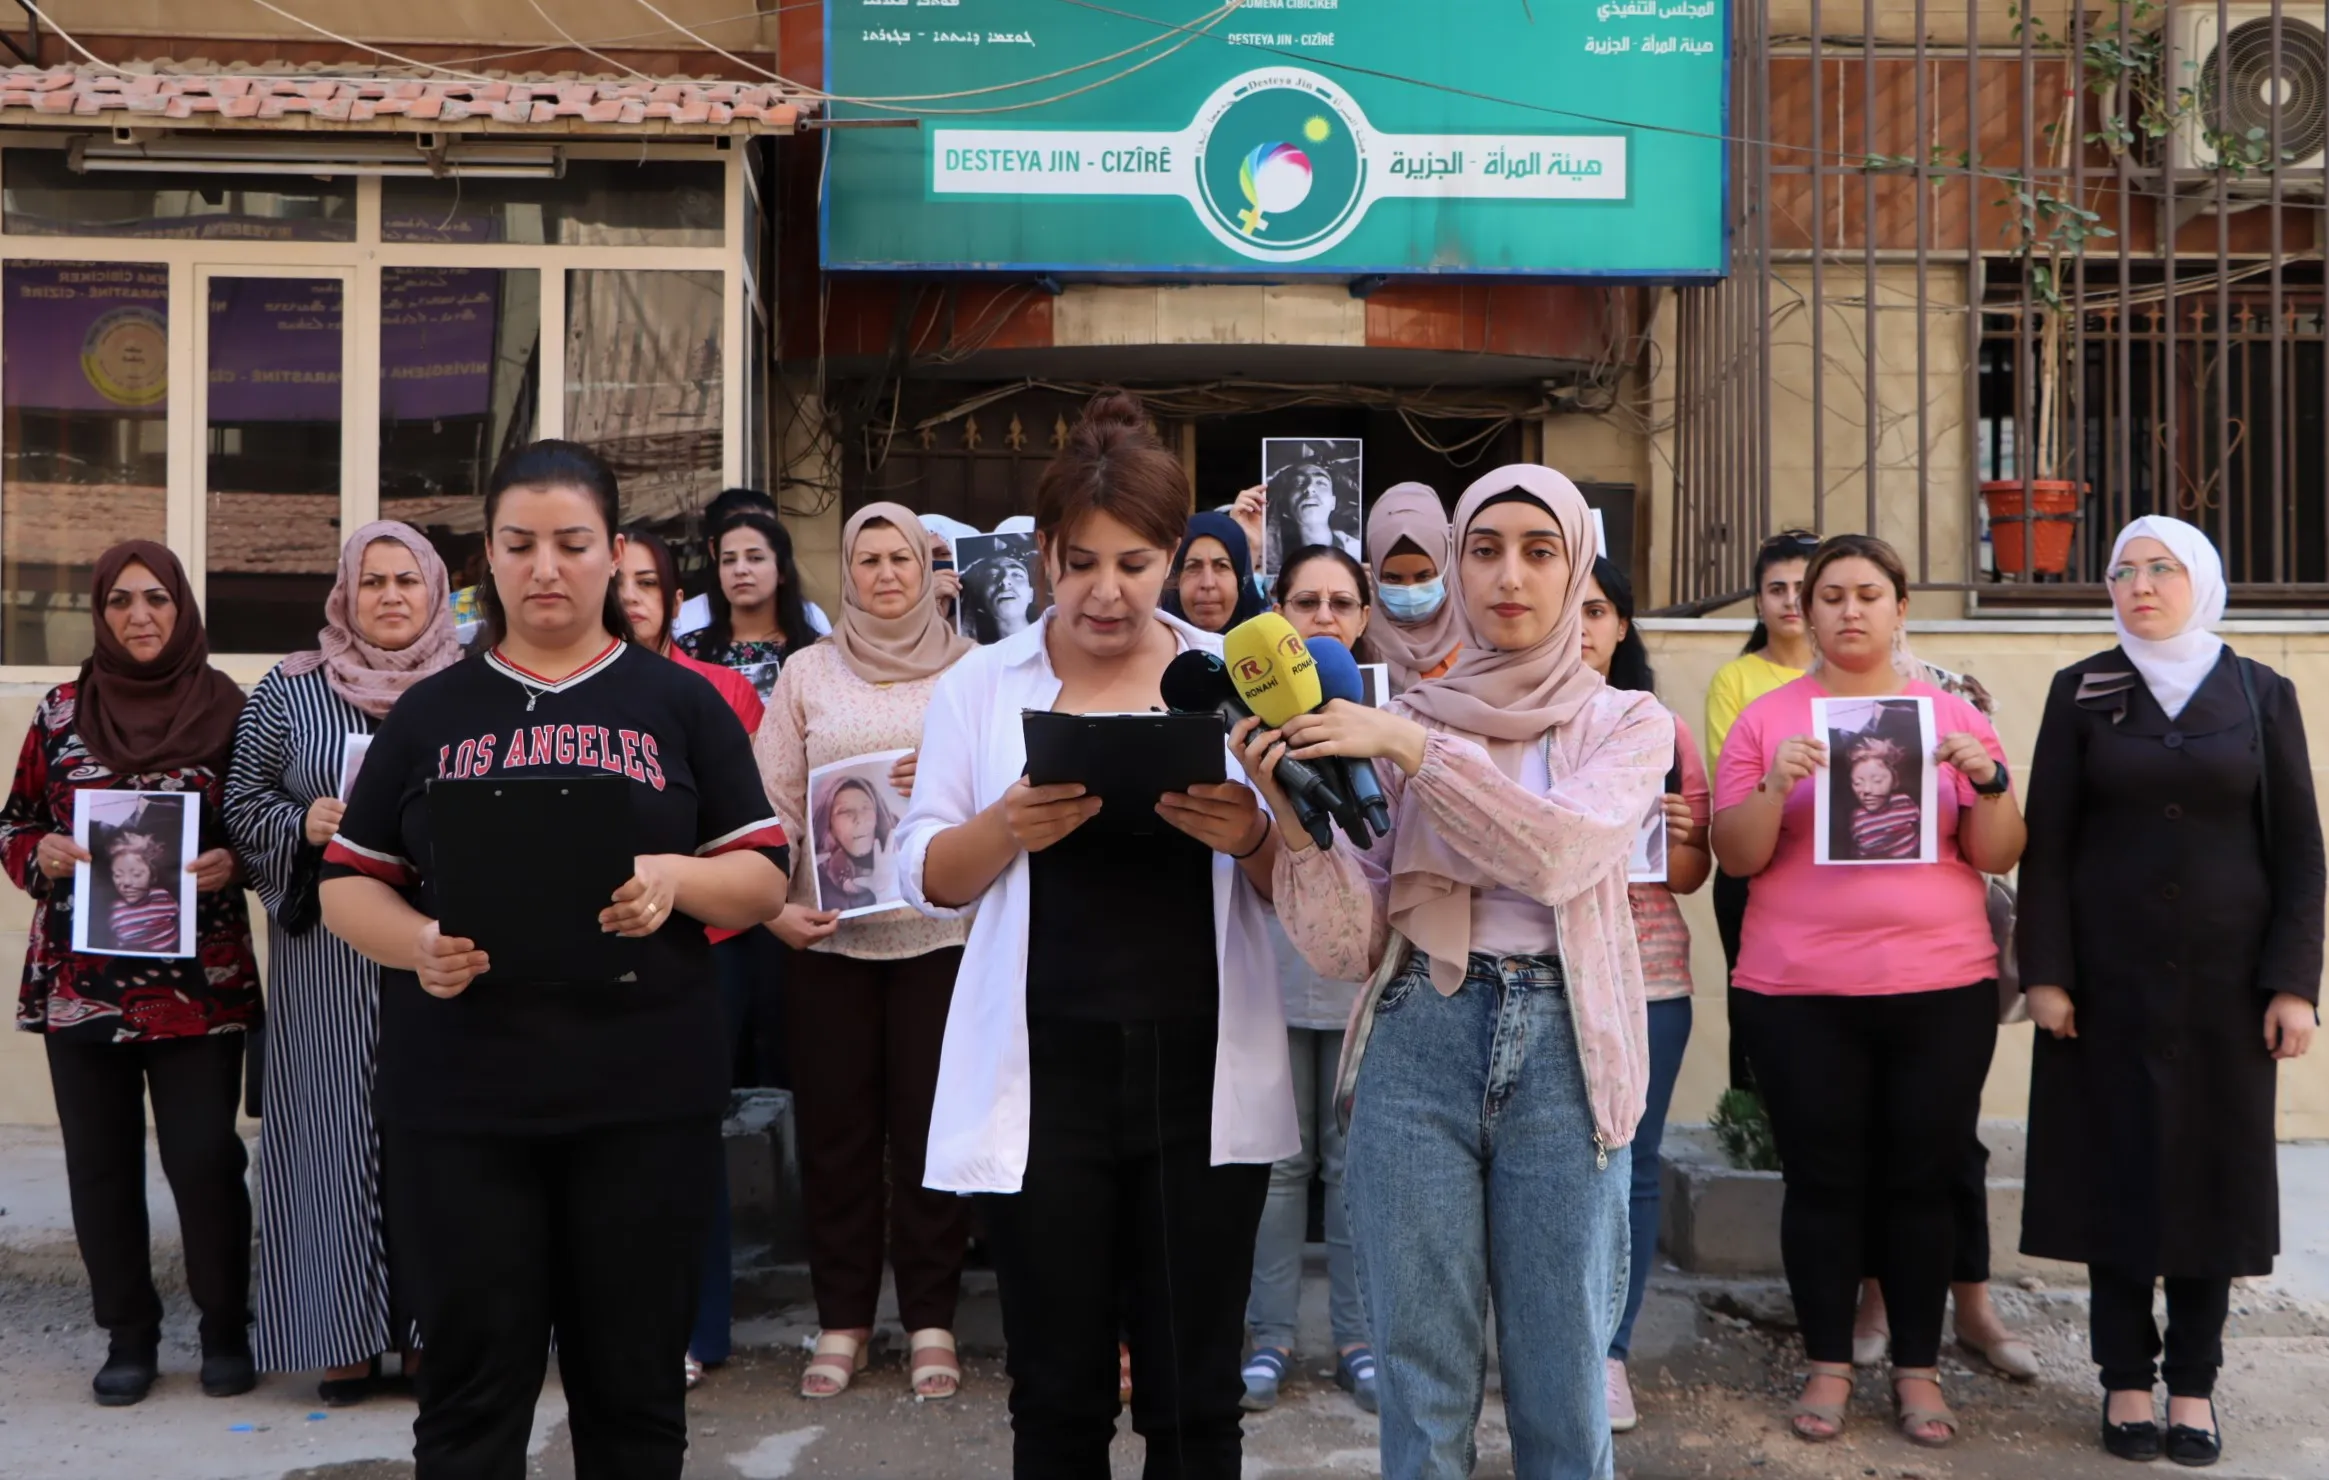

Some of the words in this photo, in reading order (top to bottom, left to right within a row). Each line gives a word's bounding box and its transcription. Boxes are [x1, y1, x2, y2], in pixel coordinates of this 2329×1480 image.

[1597, 0, 1656, 22] التنفيذي
[1658, 1, 1714, 19] المجلس
[1228, 33, 1275, 45] DESTEYA
[1276, 33, 1292, 46] JIN
[1301, 32, 1335, 46] CIZÎRÊ
[1584, 36, 1630, 55] الجزيرة
[1641, 34, 1677, 55] المرأة
[1248, 76, 1292, 91] Desteya
[1295, 76, 1313, 90] Jin
[945, 148, 1042, 172] DESTEYA
[1048, 150, 1080, 173] JIN
[1101, 146, 1172, 173] CIZÎRÊ
[1389, 150, 1463, 180] الجزيرة
[1483, 145, 1541, 180] المرأة
[1547, 152, 1603, 181] هيئة
[1286, 636, 1303, 654] R
[1240, 659, 1263, 681] R
[438, 733, 497, 780] LOS
[503, 724, 667, 792] ANGELES
